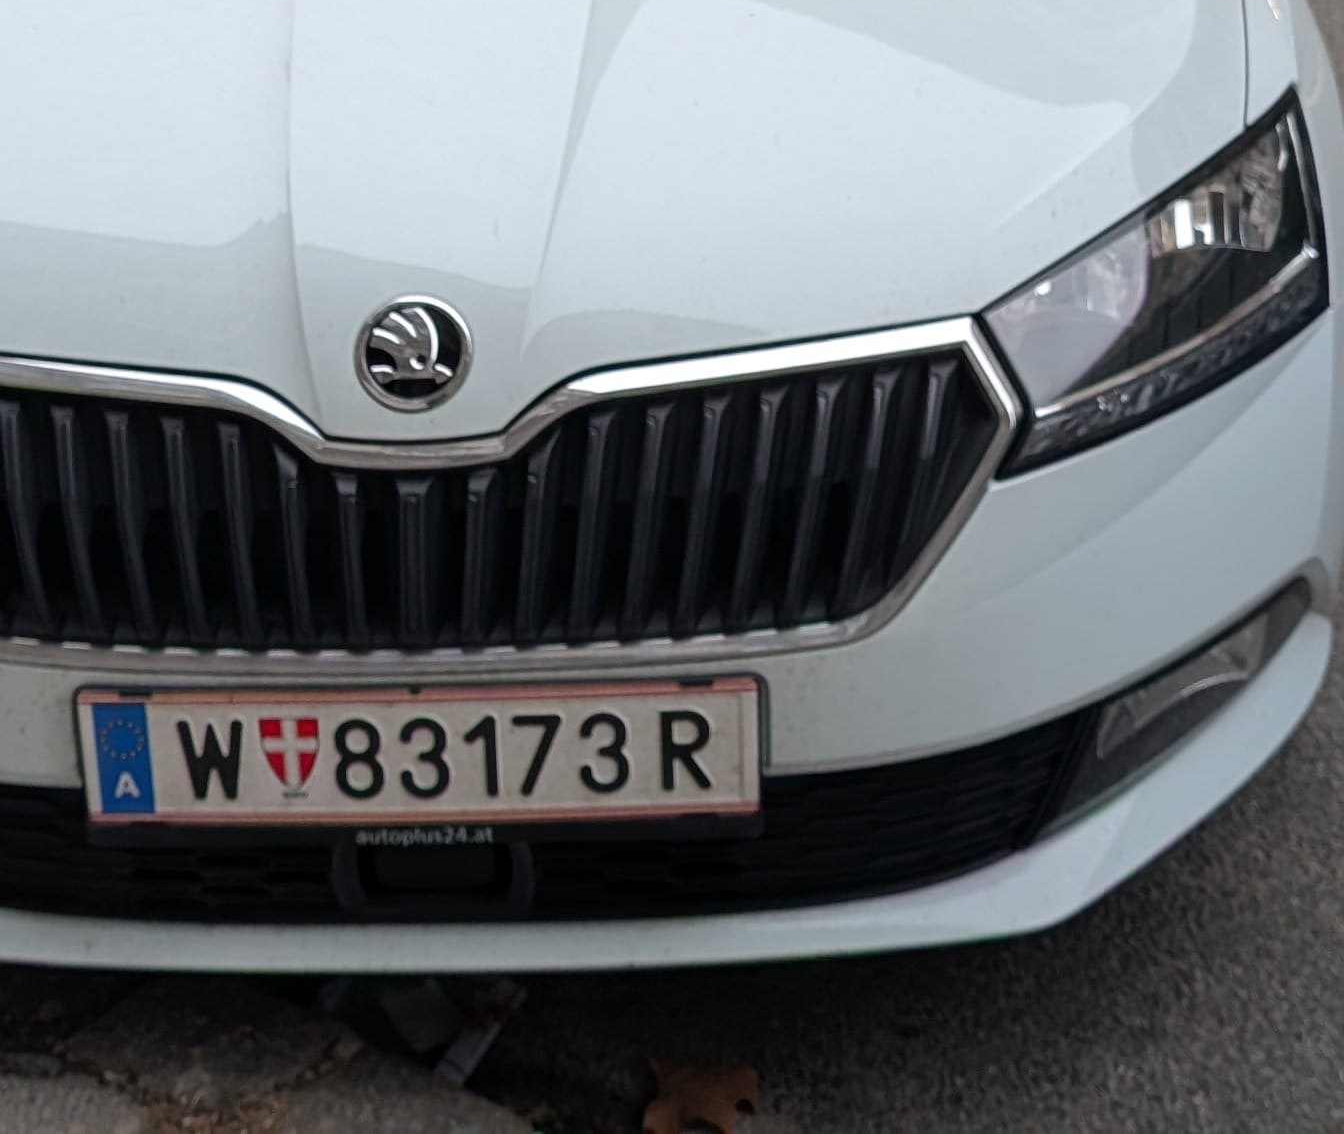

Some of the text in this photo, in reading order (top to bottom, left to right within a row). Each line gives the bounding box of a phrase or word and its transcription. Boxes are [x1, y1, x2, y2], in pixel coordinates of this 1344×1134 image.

[177, 709, 712, 800] W 83173 R
[115, 771, 140, 799] A
[355, 826, 494, 847] autoplus24.at
